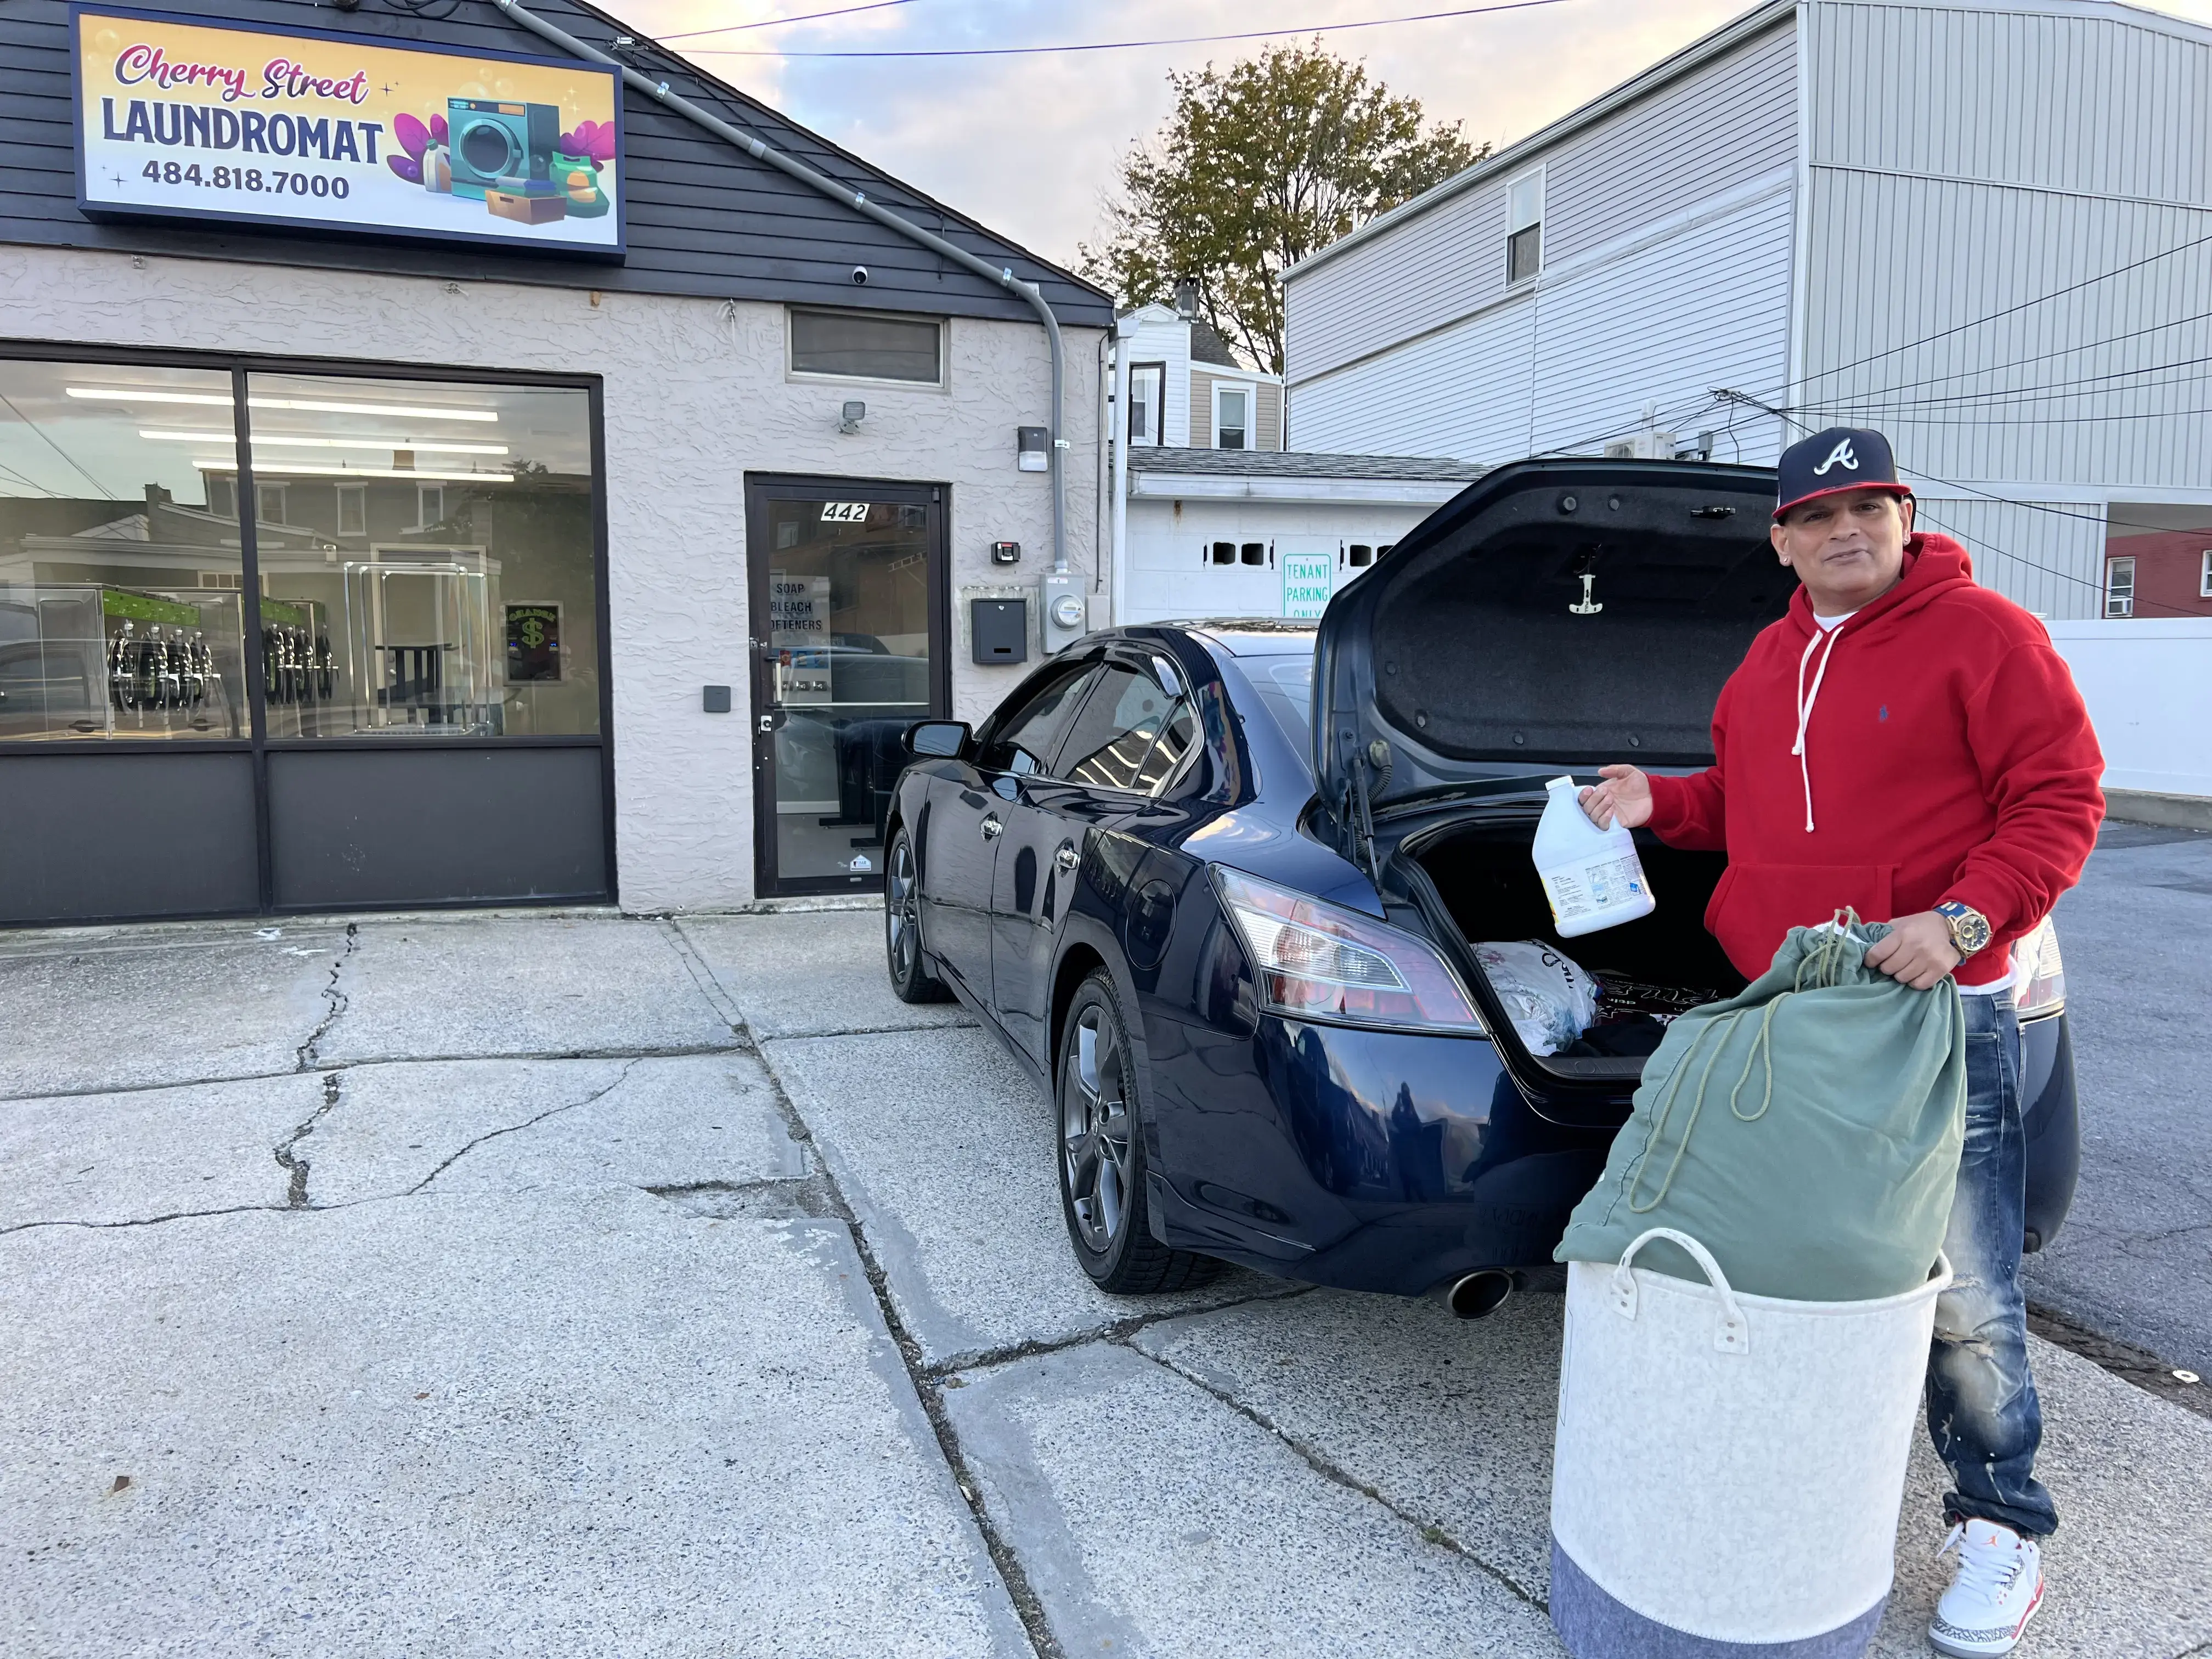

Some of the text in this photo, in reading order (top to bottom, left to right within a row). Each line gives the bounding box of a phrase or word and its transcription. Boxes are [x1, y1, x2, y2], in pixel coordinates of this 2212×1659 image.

[115, 44, 369, 104] Cherry Street
[101, 97, 383, 164] LAUNDROMAT
[142, 160, 349, 199] 484.818.7000
[1814, 437, 1859, 476] A
[824, 503, 865, 520] 442
[1287, 564, 1328, 579] TENANT
[777, 583, 805, 594] SOAP
[1287, 587, 1328, 601] PARKING
[770, 602, 812, 612] BLEACH
